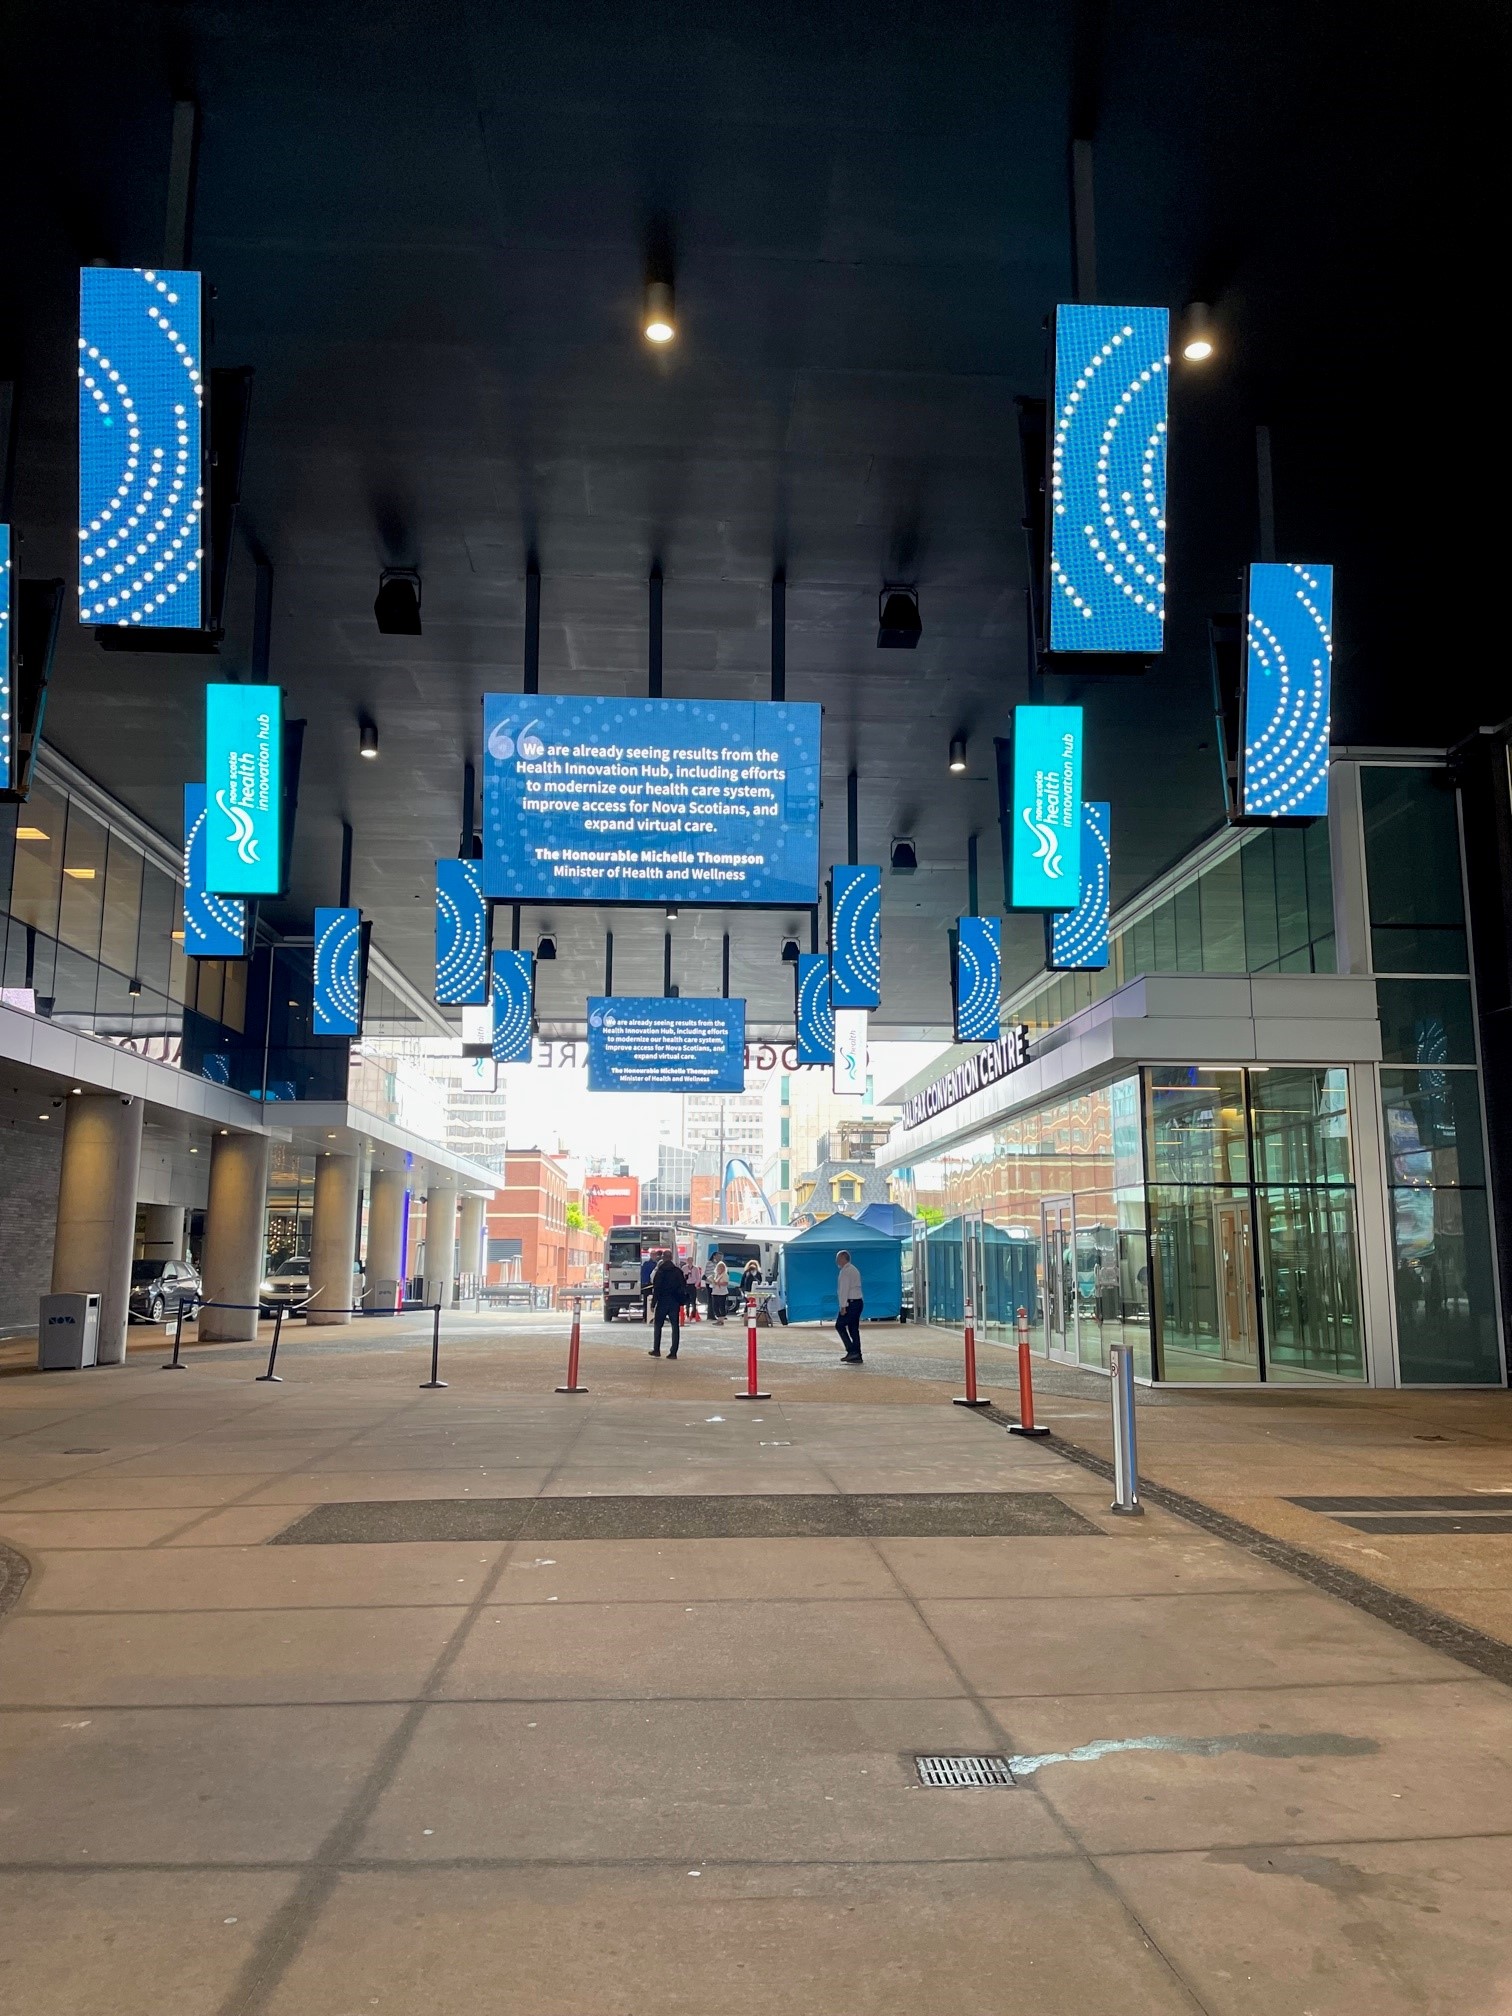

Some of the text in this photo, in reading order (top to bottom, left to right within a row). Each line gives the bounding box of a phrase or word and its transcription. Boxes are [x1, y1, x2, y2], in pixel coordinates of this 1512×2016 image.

[257, 714, 270, 811] innovation hub
[524, 743, 778, 762] We are already seeing results from the
[228, 752, 237, 780] scotia
[516, 761, 786, 782] Health Innovation Hub, including efforts
[238, 753, 254, 808] health
[526, 780, 774, 800] to modernize our health care system,
[1034, 770, 1044, 798] scotia
[1062, 733, 1074, 828] innovation hub
[522, 797, 778, 817] improve access for Nova Scotians, and
[1044, 772, 1059, 824] health
[584, 818, 718, 832] expand virtual care.
[534, 848, 764, 866] The Honourable Michelle Thompson
[554, 865, 746, 880] Minister of Health and Wellness
[903, 1025, 1024, 1130] HALIFAX CONVENTION CENTRE
